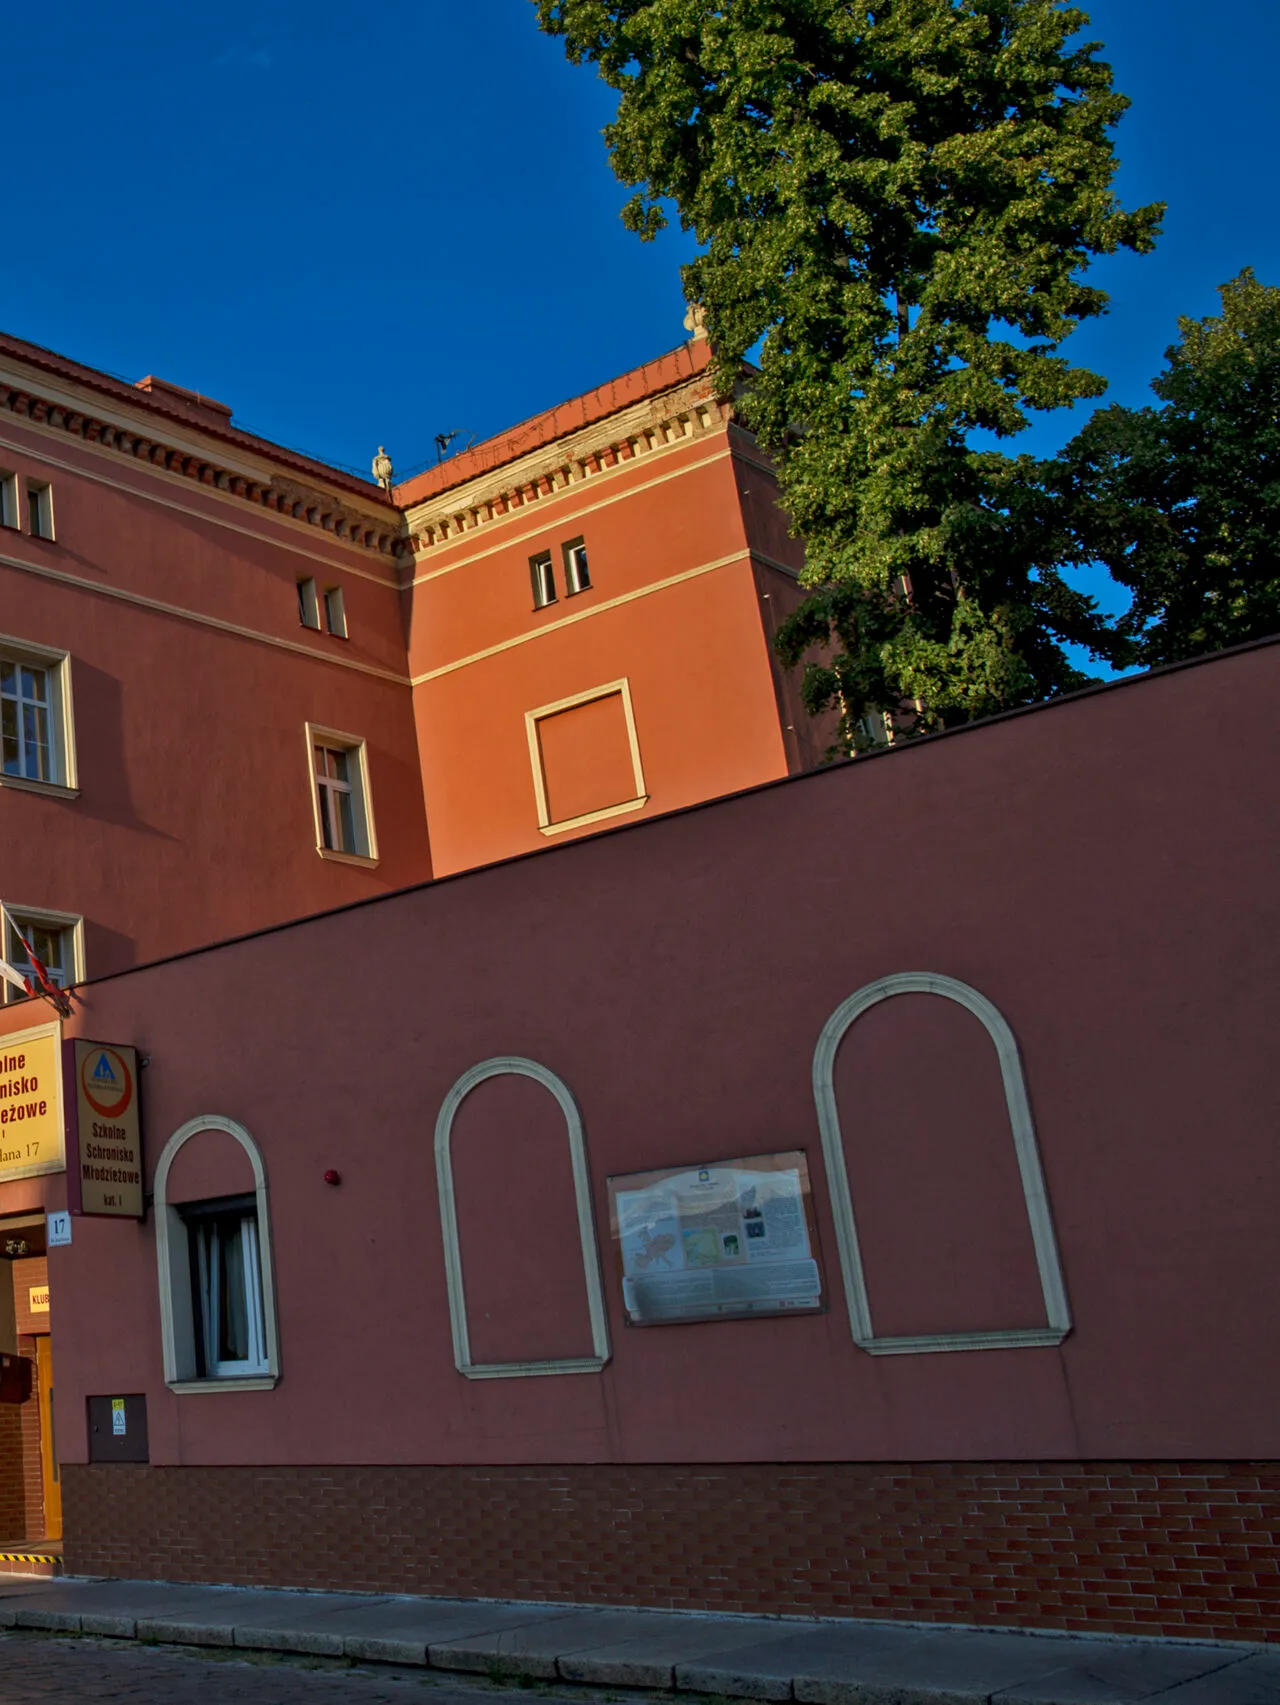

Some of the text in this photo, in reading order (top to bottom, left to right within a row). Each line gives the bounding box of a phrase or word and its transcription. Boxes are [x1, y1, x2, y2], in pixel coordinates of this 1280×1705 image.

[92, 1122, 126, 1141] Szkolne
[26, 1142, 39, 1157] 17
[86, 1143, 134, 1163] Schronisko
[82, 1164, 140, 1184] Młodzieżowe
[103, 1193, 117, 1208] kat.
[54, 1219, 65, 1234] 17
